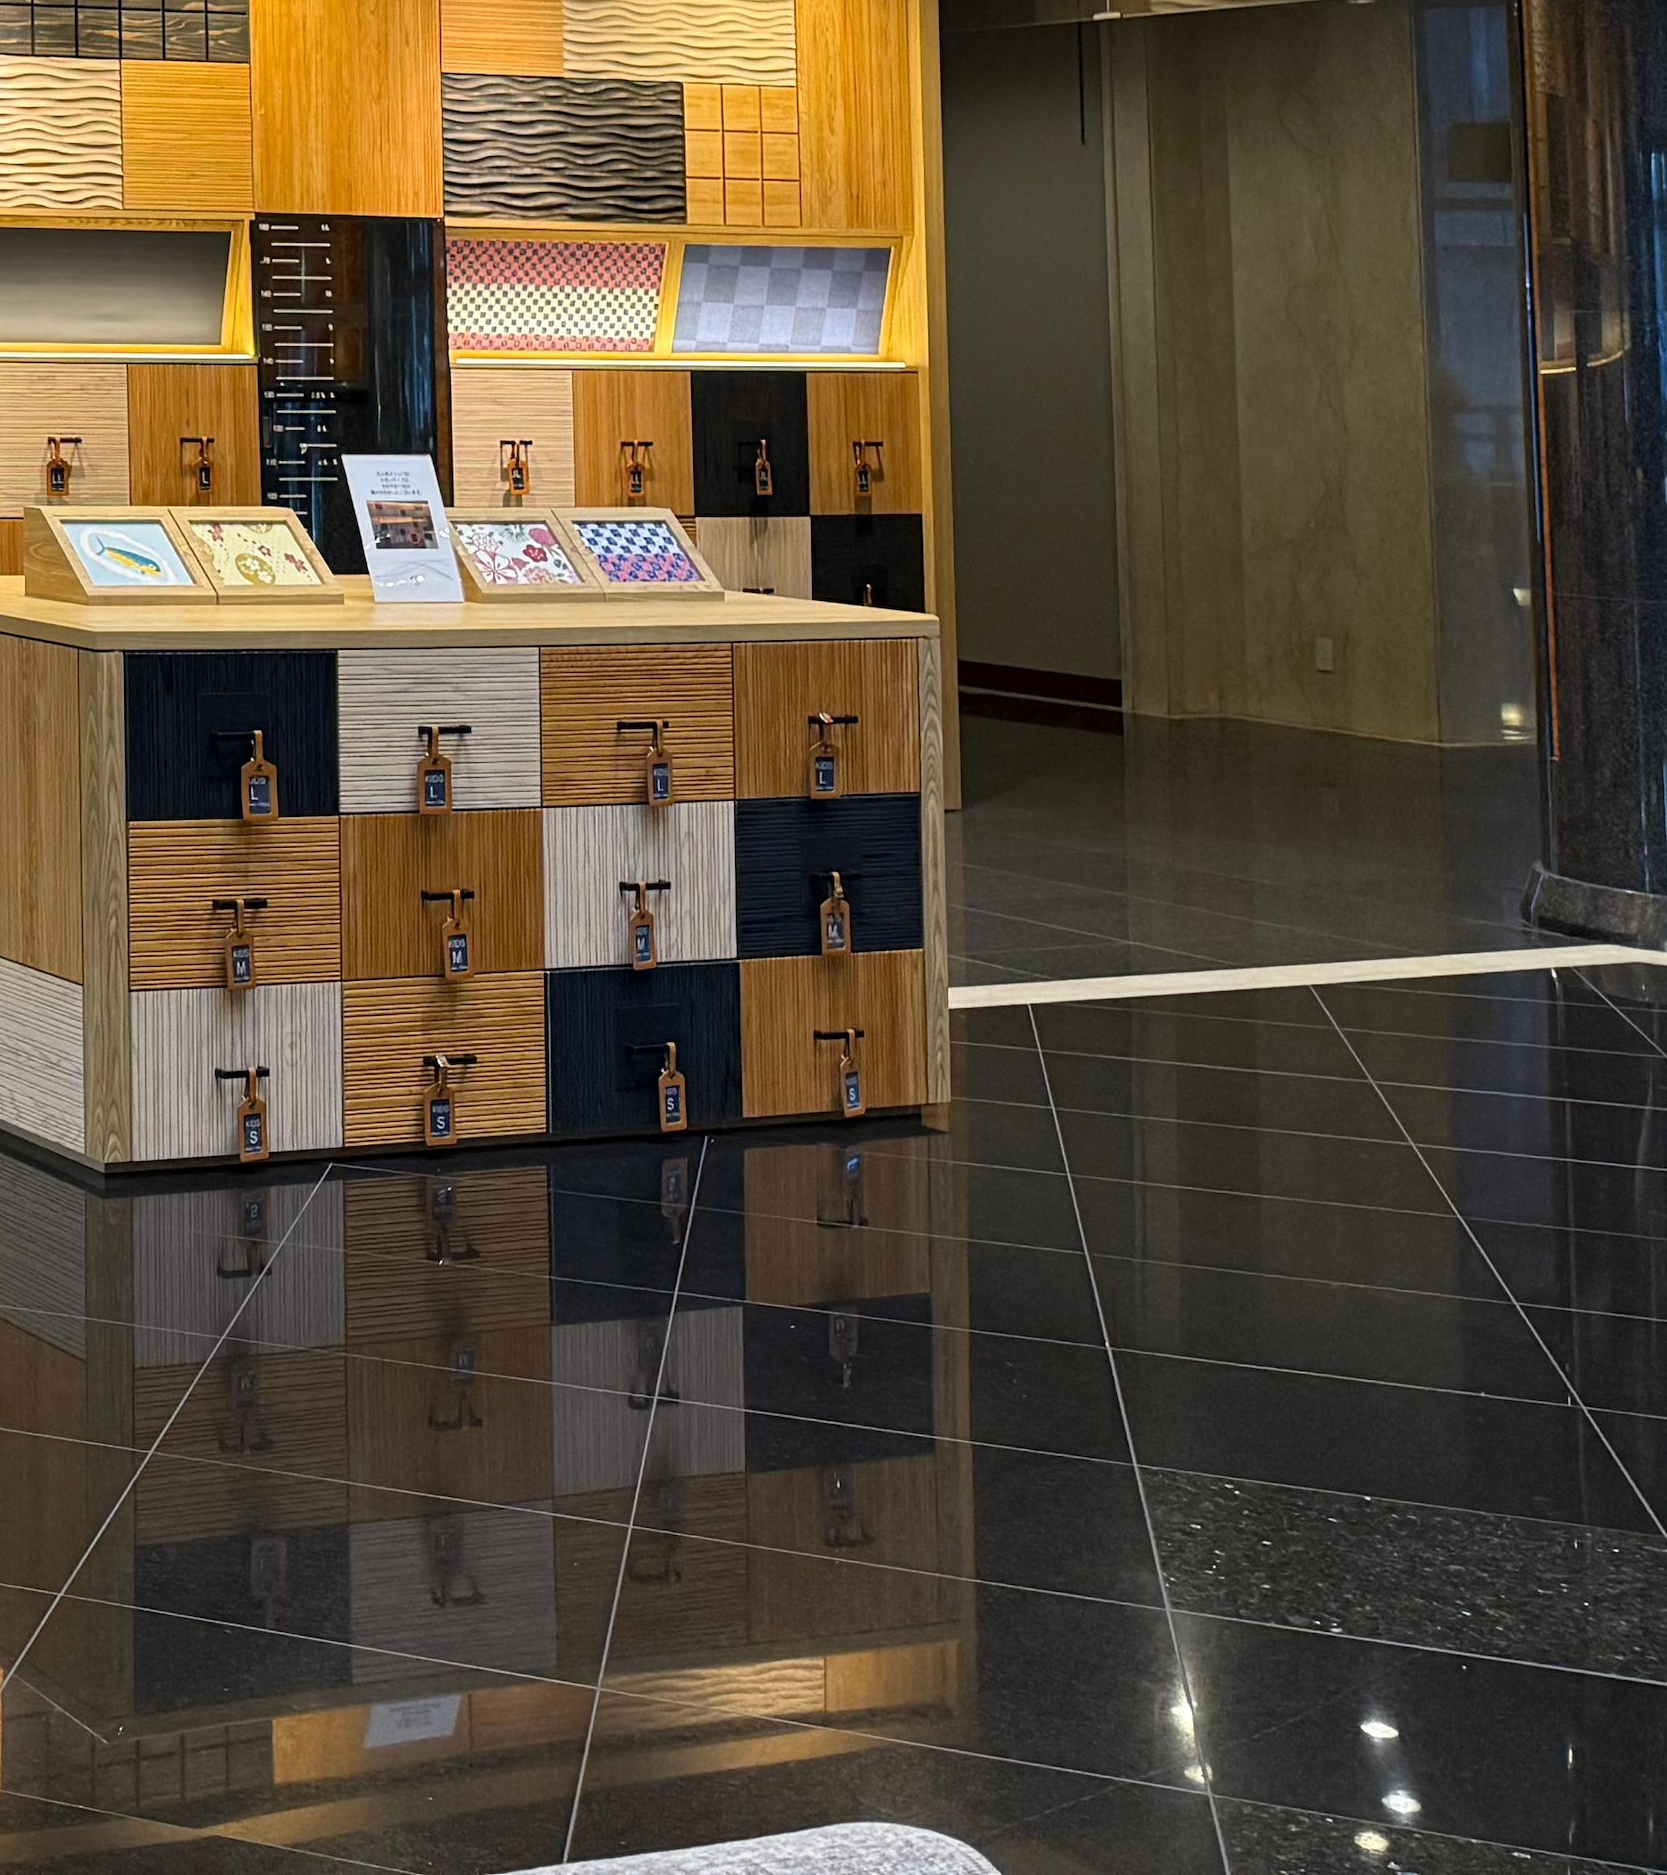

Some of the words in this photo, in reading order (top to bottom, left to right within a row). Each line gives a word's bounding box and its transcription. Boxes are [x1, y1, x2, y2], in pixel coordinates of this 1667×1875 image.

[202, 471, 209, 484] L
[819, 771, 826, 784] L
[657, 778, 664, 791] L
[251, 786, 259, 800] L
[430, 786, 437, 798] L
[828, 924, 839, 938] M
[637, 937, 645, 951] M
[452, 950, 463, 964] M
[237, 961, 247, 975] M
[849, 1088, 856, 1101] S
[667, 1097, 674, 1110] S
[437, 1116, 445, 1129] S
[249, 1131, 257, 1144] S
